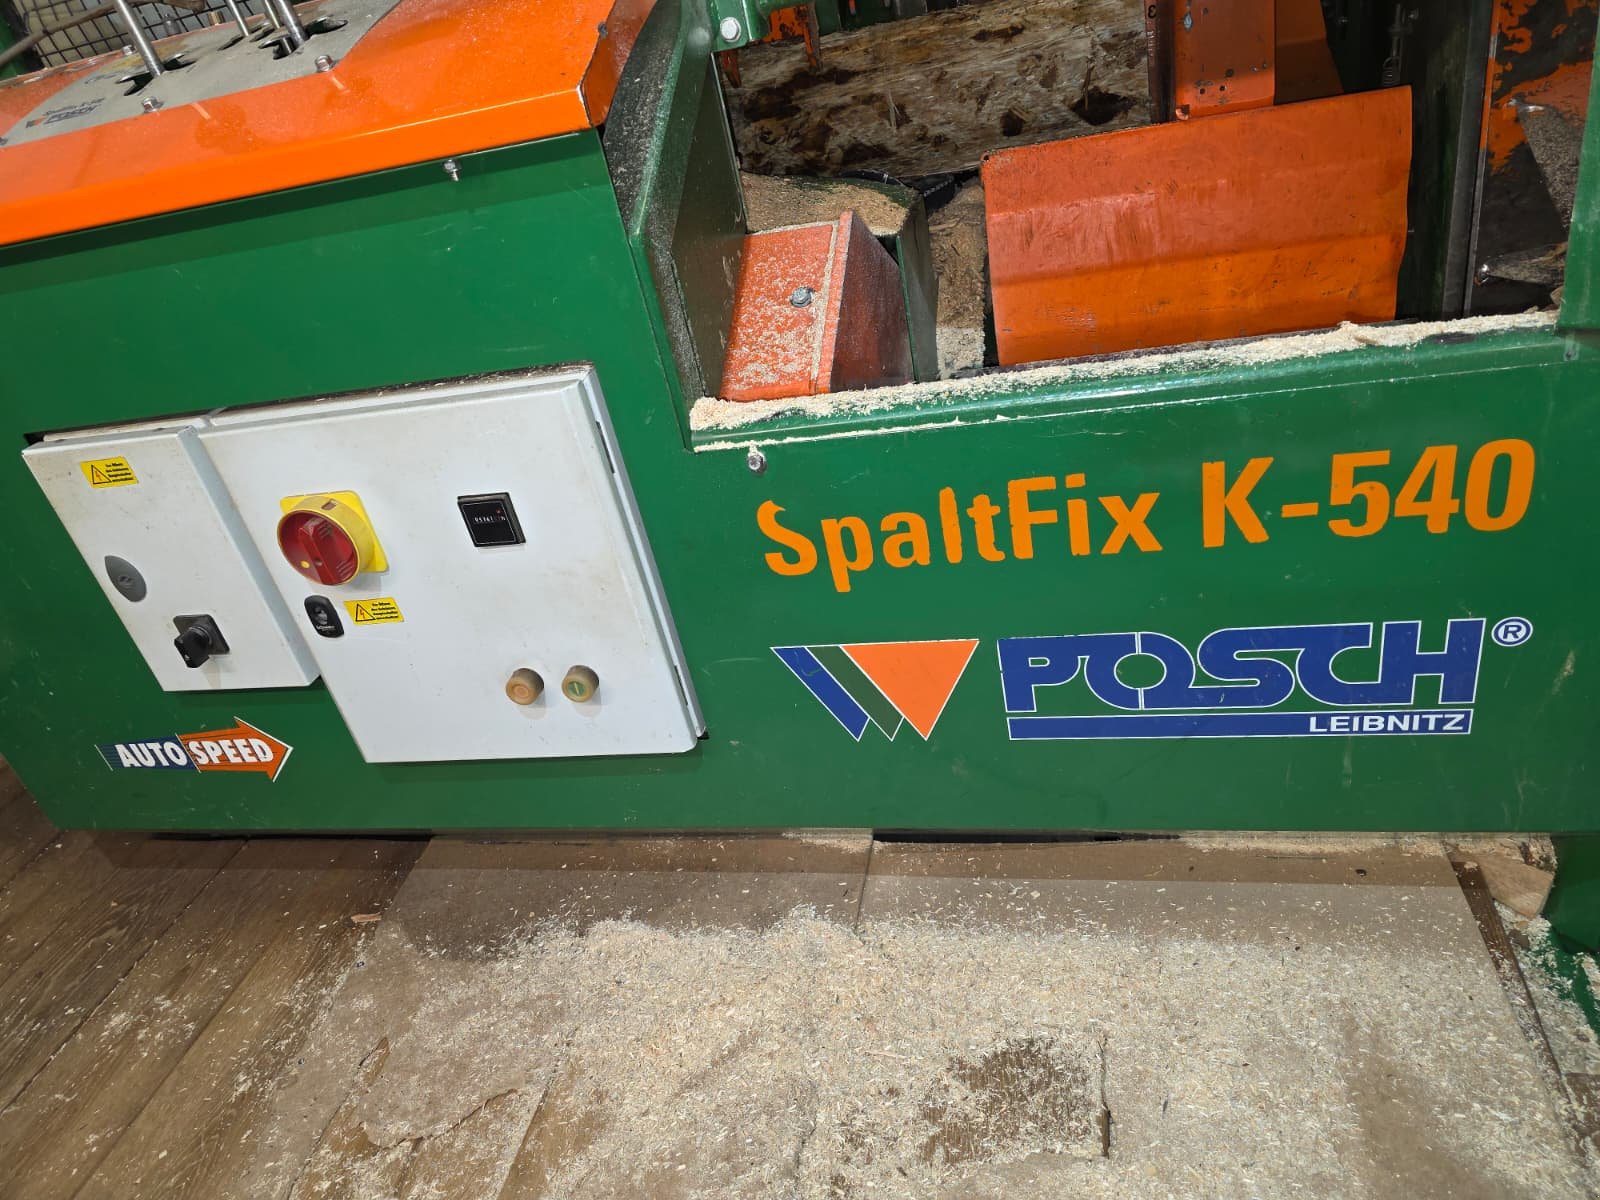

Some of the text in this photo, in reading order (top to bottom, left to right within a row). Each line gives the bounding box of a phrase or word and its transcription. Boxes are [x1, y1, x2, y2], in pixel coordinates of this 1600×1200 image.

[756, 438, 1536, 593] SpaltFix K-540
[996, 617, 1487, 712] POSCH
[114, 738, 274, 768] AUTO SPEED
[1309, 713, 1465, 734] LEIBNITZ
